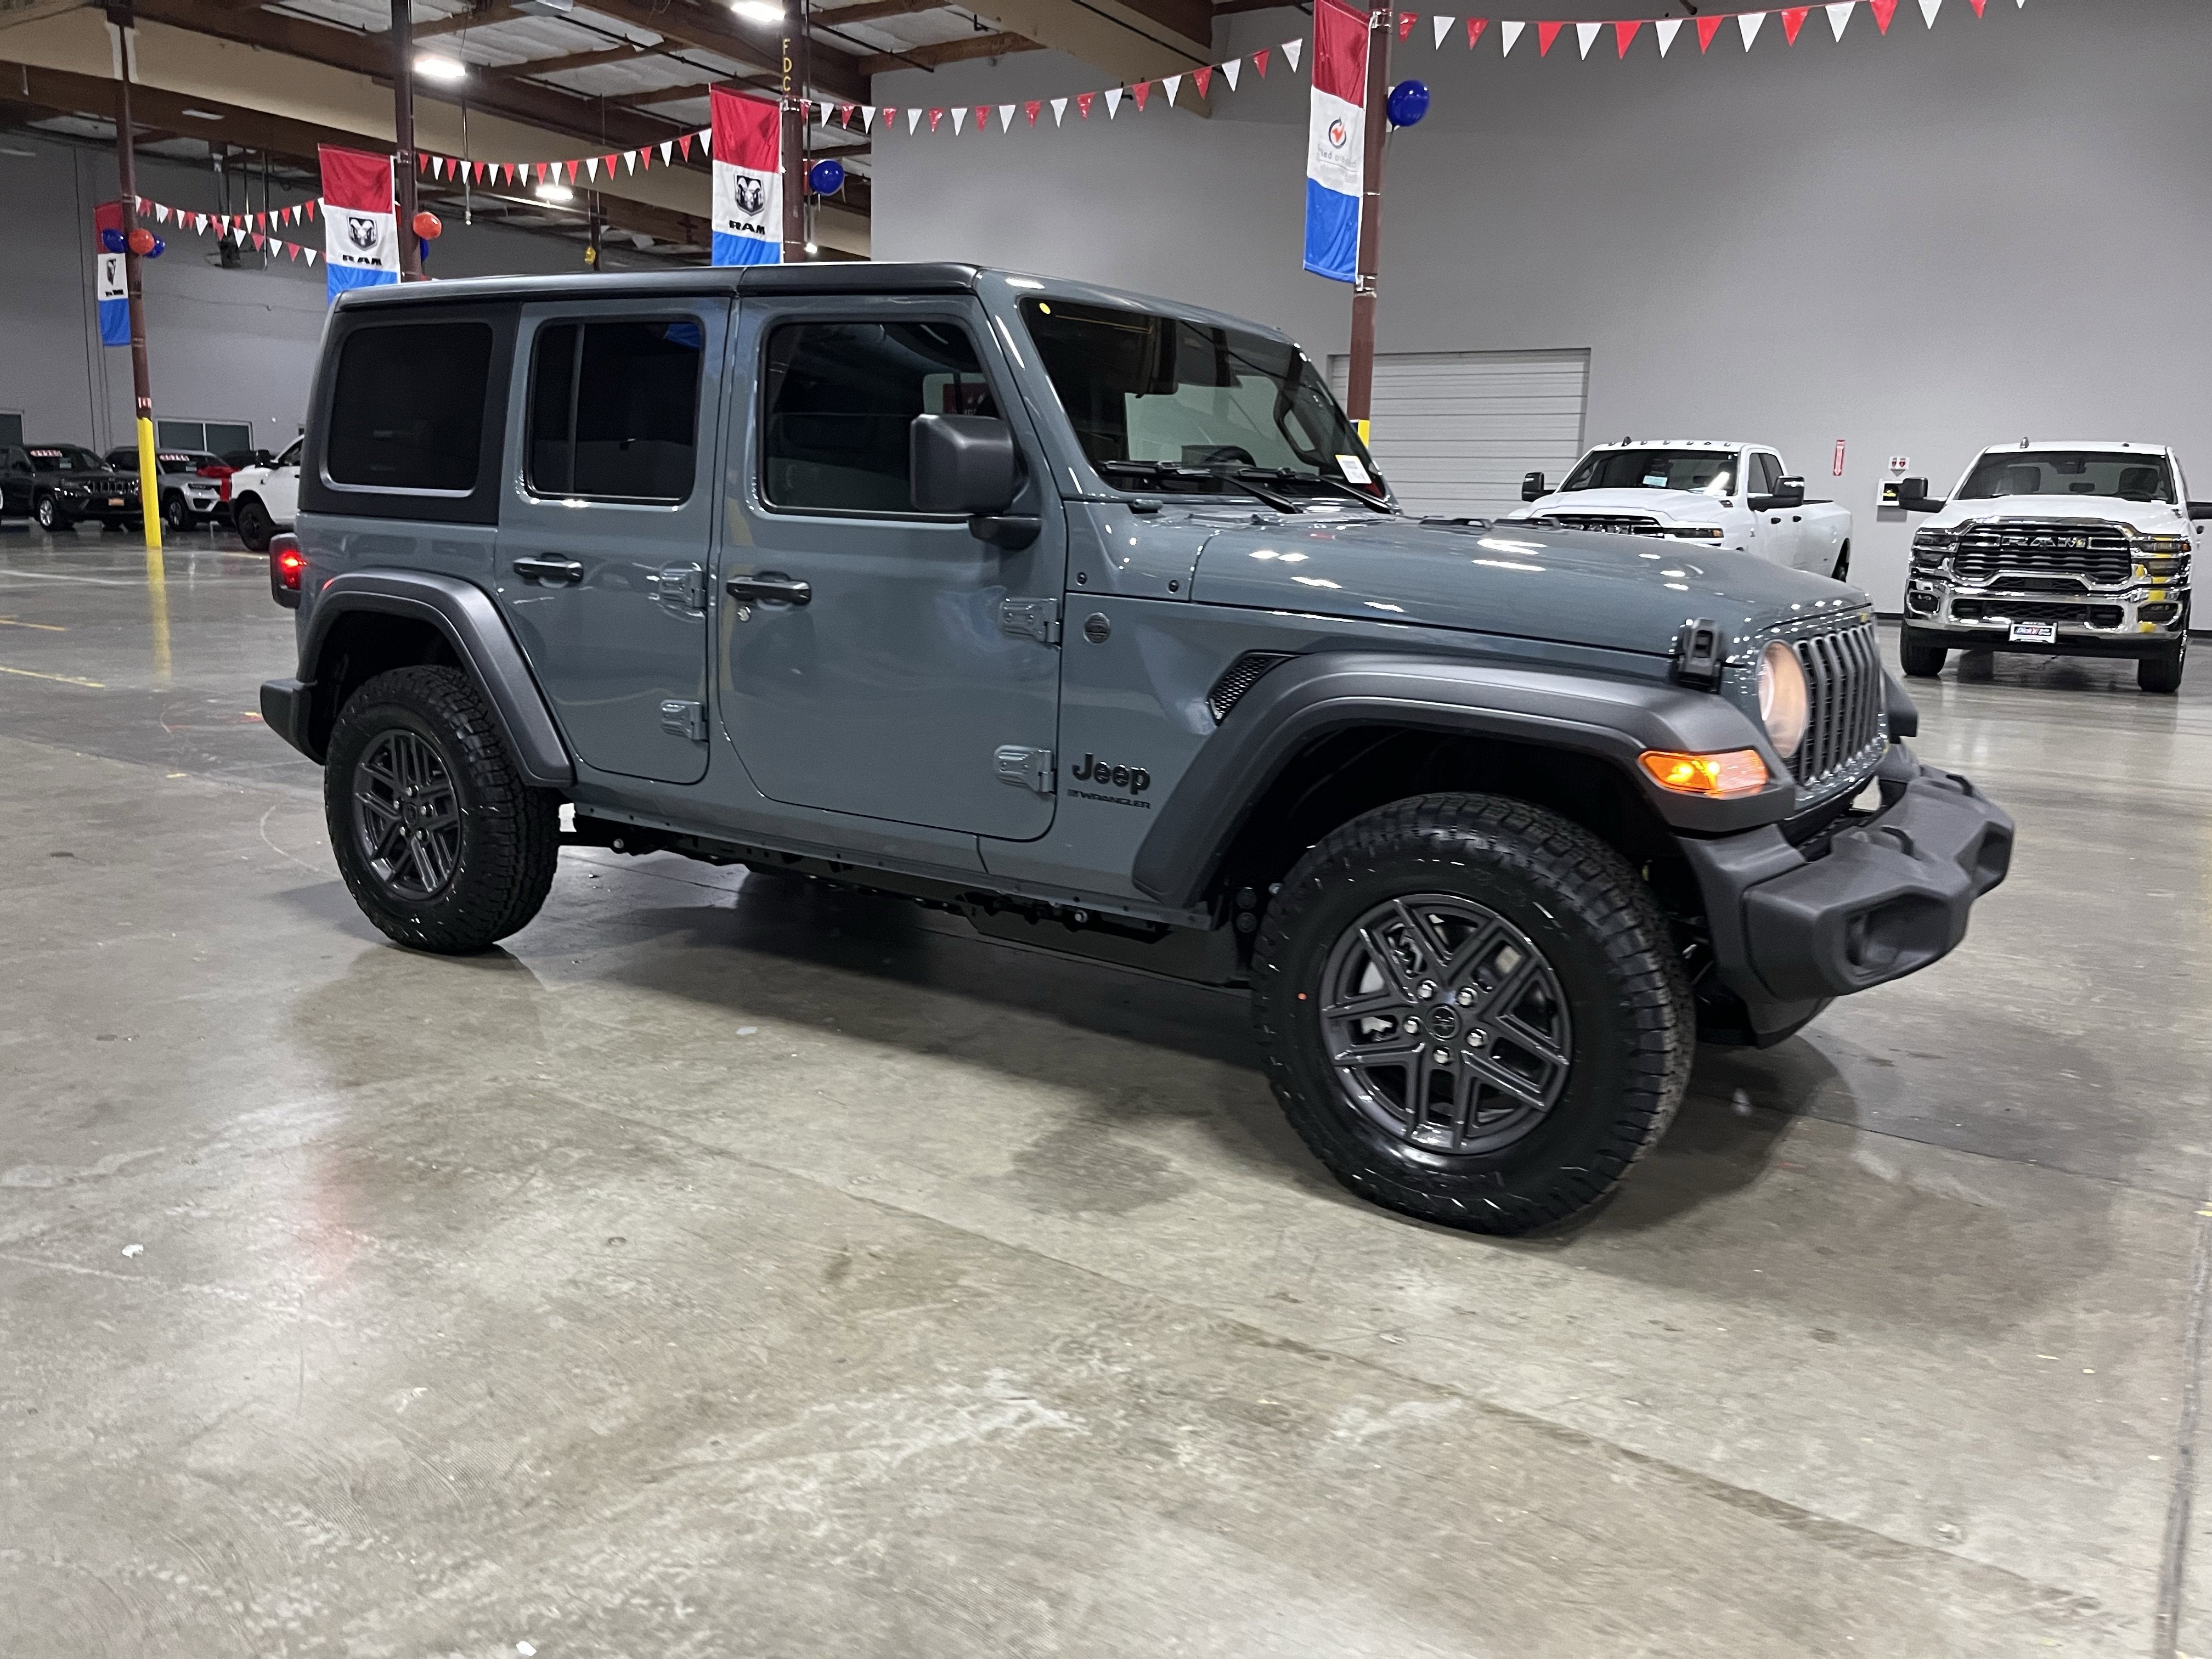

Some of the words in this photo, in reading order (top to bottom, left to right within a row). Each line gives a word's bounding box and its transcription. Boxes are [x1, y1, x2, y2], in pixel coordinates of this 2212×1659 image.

[729, 220, 765, 235] RAM
[2001, 535, 2086, 548] RAM
[1071, 752, 1150, 794] Jeep
[1077, 791, 1150, 809] WRANGLER
